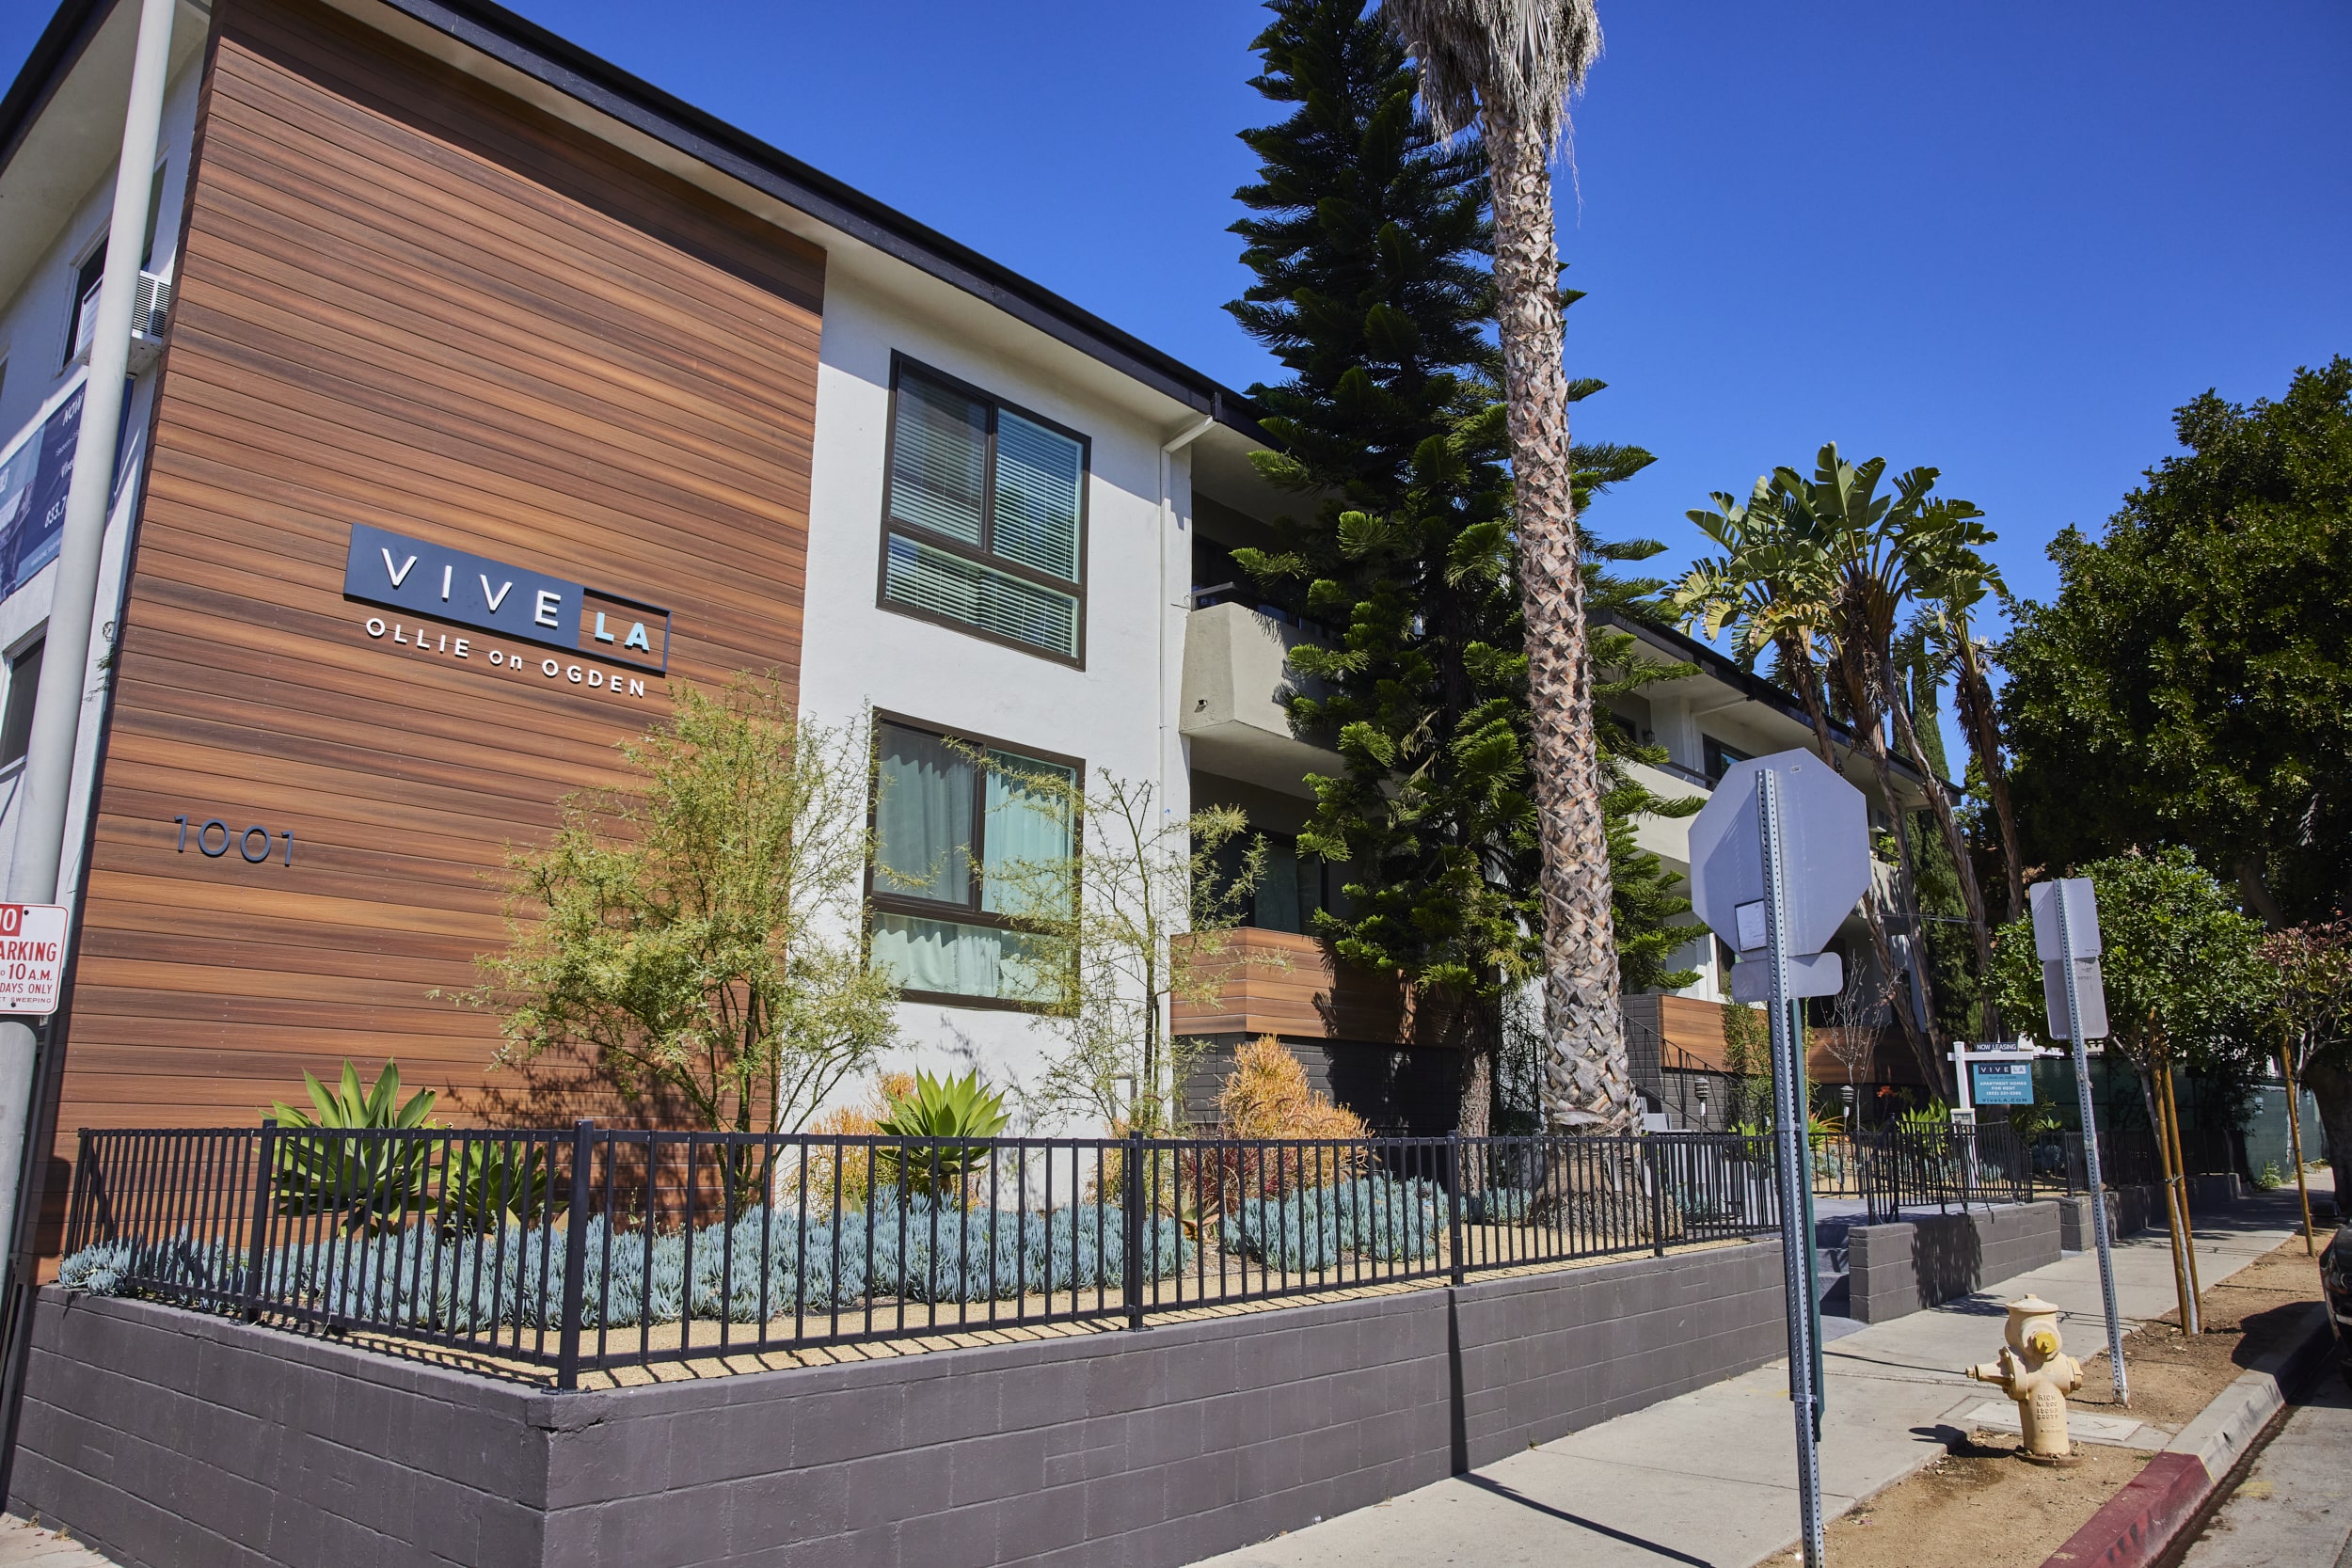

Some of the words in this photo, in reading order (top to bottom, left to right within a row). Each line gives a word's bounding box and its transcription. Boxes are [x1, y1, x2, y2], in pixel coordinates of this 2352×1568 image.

[381, 547, 562, 627] VIVE
[594, 611, 650, 653] LA
[365, 617, 469, 658] OLLIE
[488, 650, 522, 671] on
[541, 658, 645, 698] OGDEN
[174, 815, 294, 867] 1001
[0, 908, 17, 932] O
[8, 963, 26, 980] 10
[27, 969, 53, 981] A.M.
[28, 983, 53, 994] ONLY
